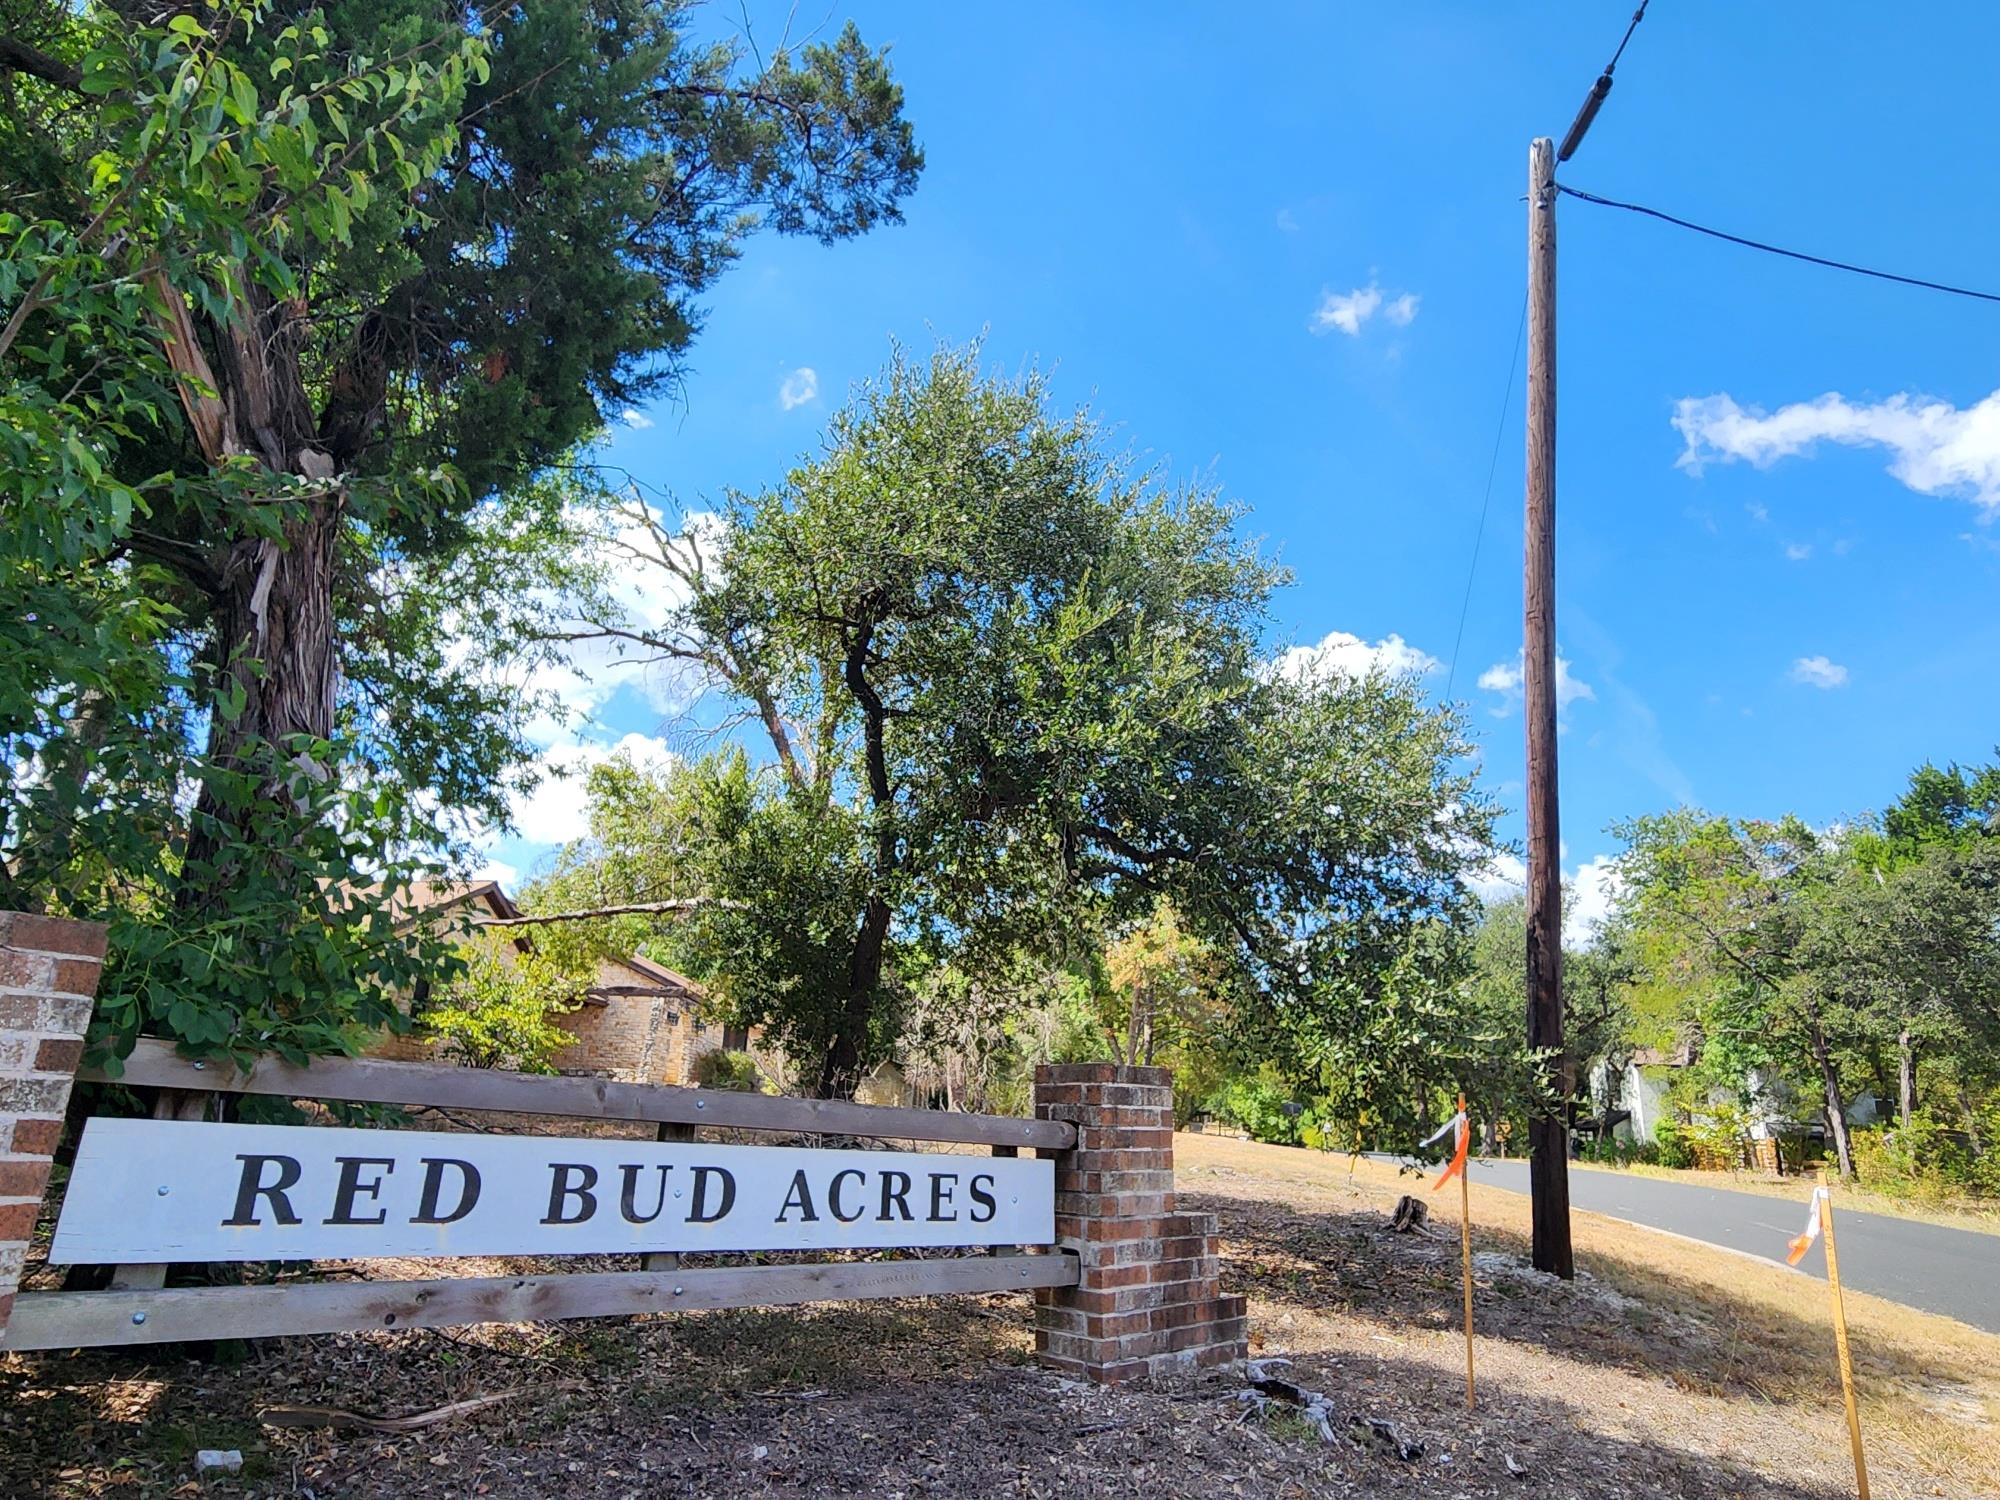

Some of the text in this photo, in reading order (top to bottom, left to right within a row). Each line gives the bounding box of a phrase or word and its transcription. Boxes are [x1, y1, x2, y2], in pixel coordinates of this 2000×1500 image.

[221, 1154, 997, 1226] RED BUD ACRES
